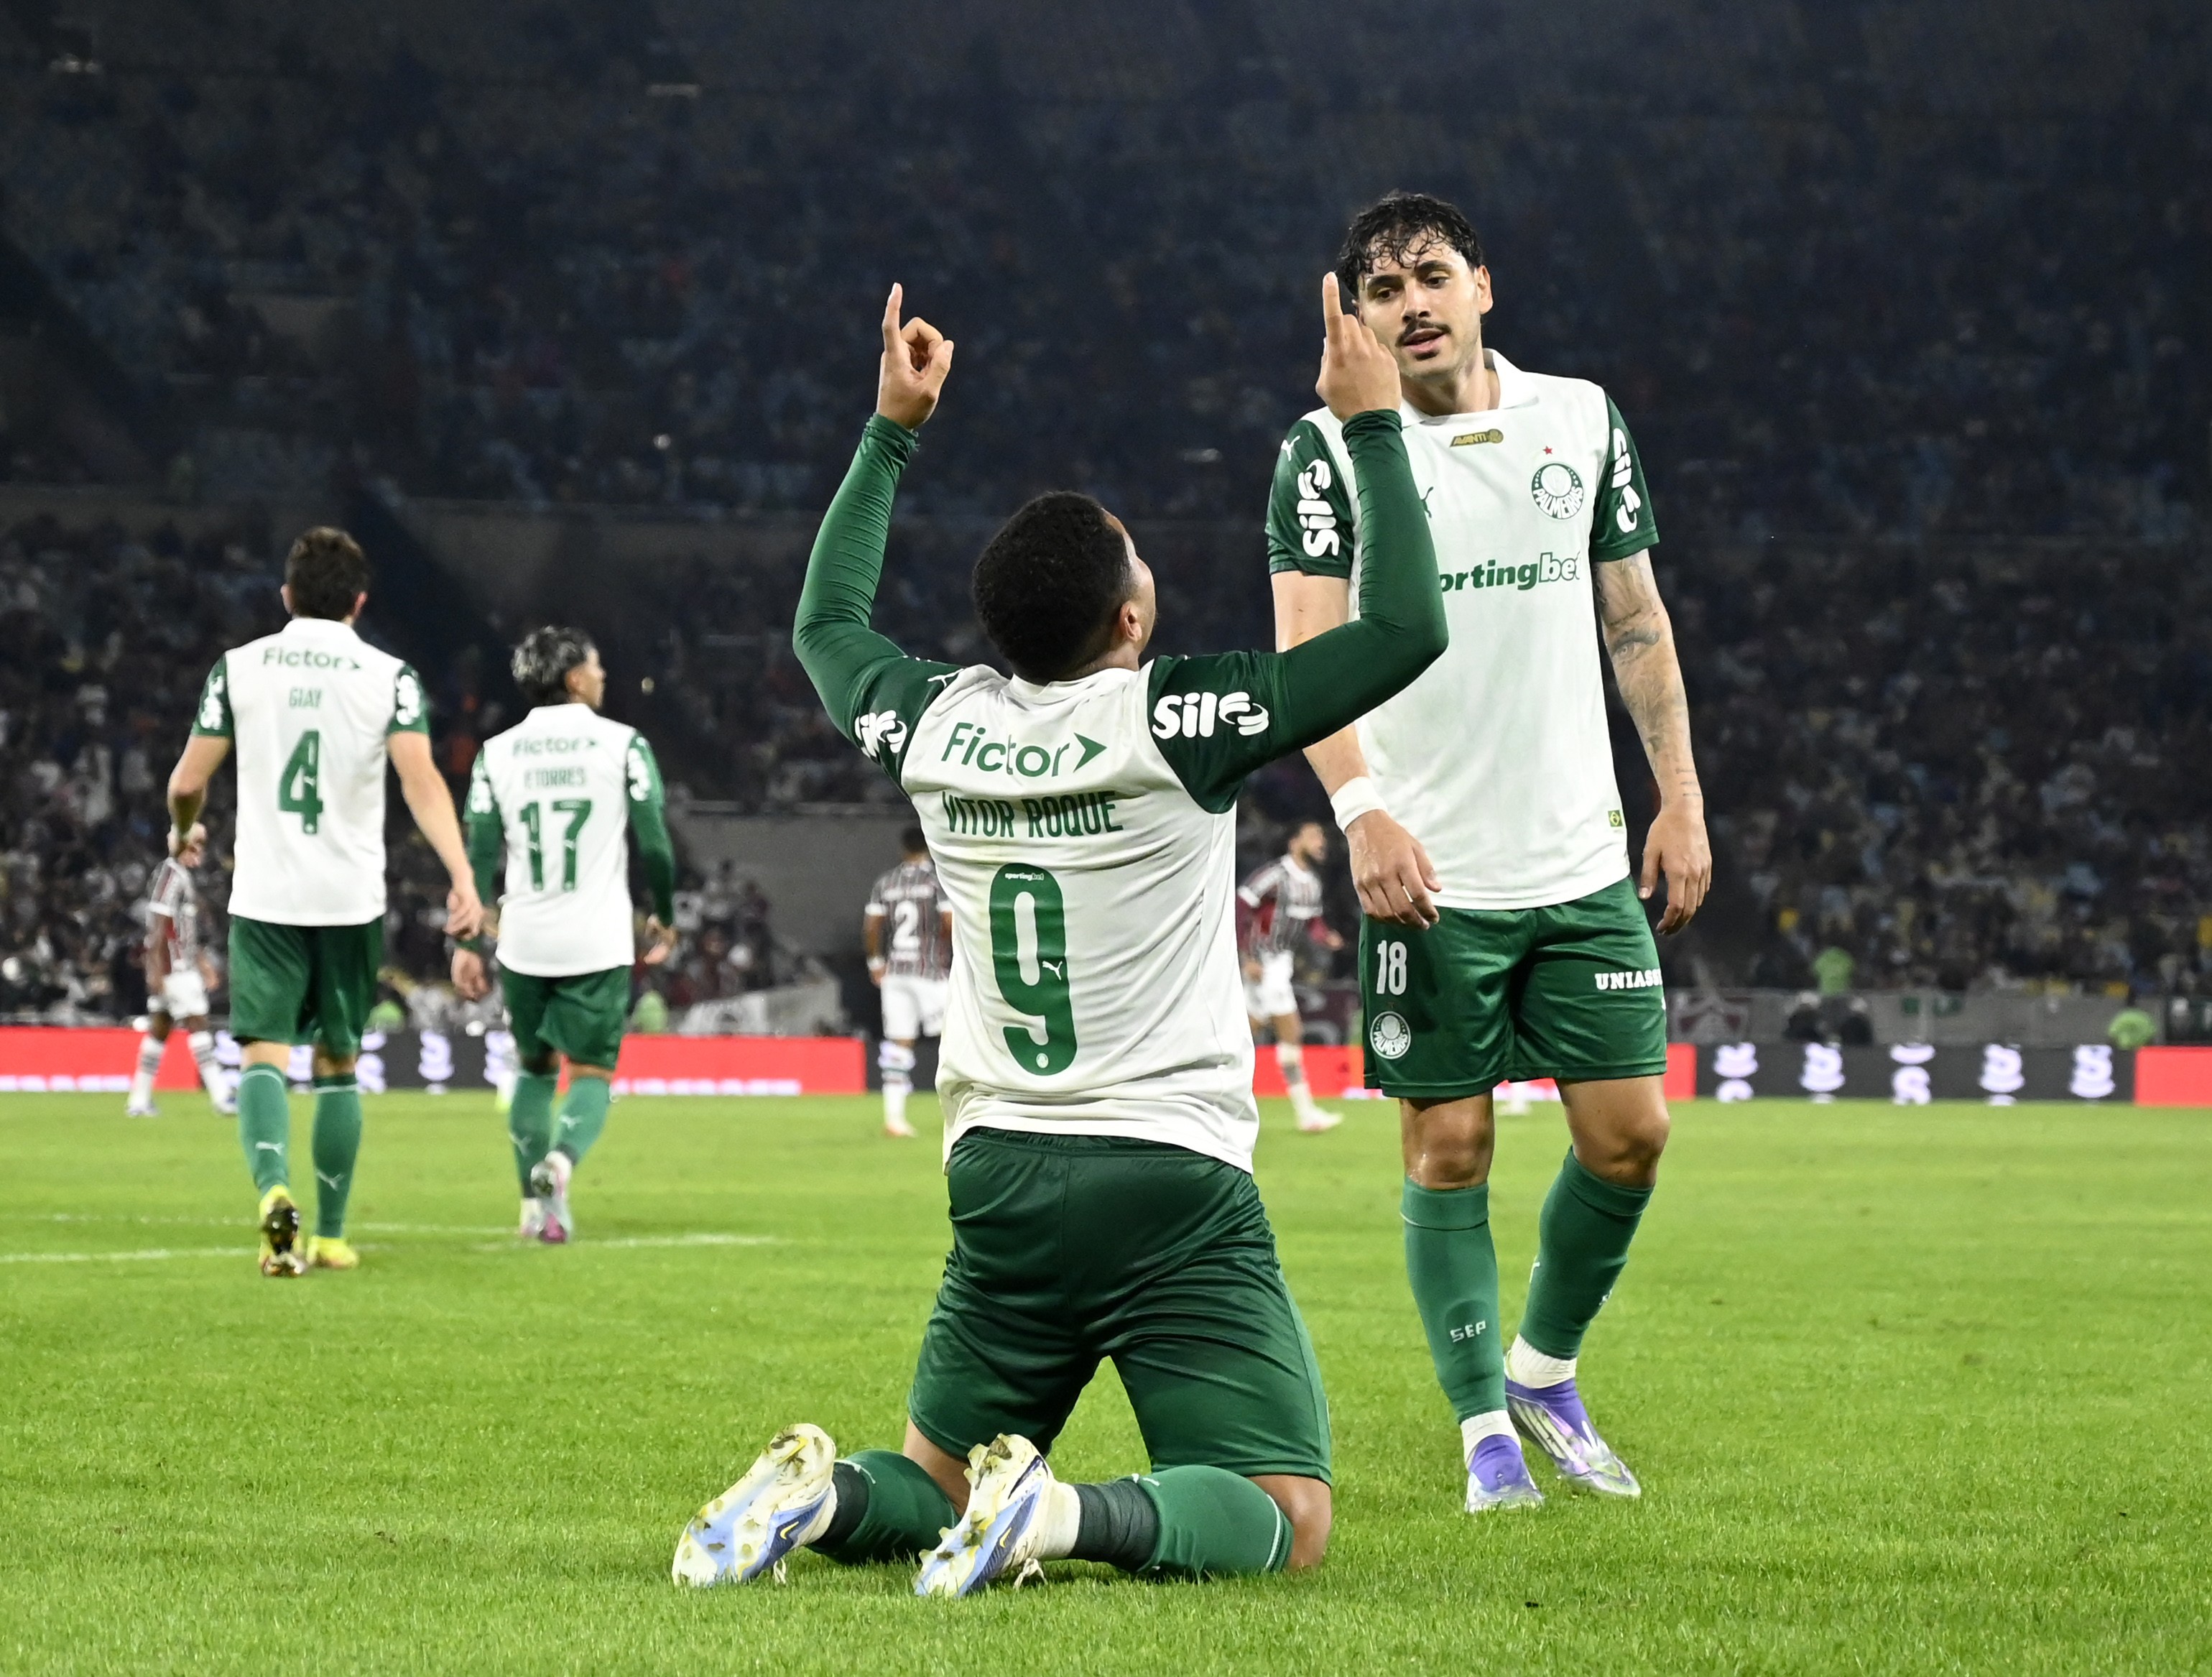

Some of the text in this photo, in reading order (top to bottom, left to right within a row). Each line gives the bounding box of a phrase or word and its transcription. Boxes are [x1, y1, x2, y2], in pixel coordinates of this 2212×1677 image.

[1453, 433, 1486, 445] AVANTI
[1532, 486, 1583, 519] PALMEIRAS
[1439, 551, 1581, 593] ortingbe
[263, 646, 343, 669] Fictor
[288, 686, 323, 708] GIAY
[941, 722, 1070, 777] Fictor
[278, 729, 323, 833] 4
[535, 766, 586, 788] TORRES
[942, 790, 1124, 839] VITOR ROQUE
[519, 800, 593, 892] 17
[1005, 872, 1044, 882] sportingbet
[892, 900, 920, 950] 2
[989, 862, 1078, 1076] 9
[1376, 940, 1407, 996] 18
[1374, 1031, 1408, 1055] PALMEIRAS
[1450, 1320, 1487, 1343] SEP
